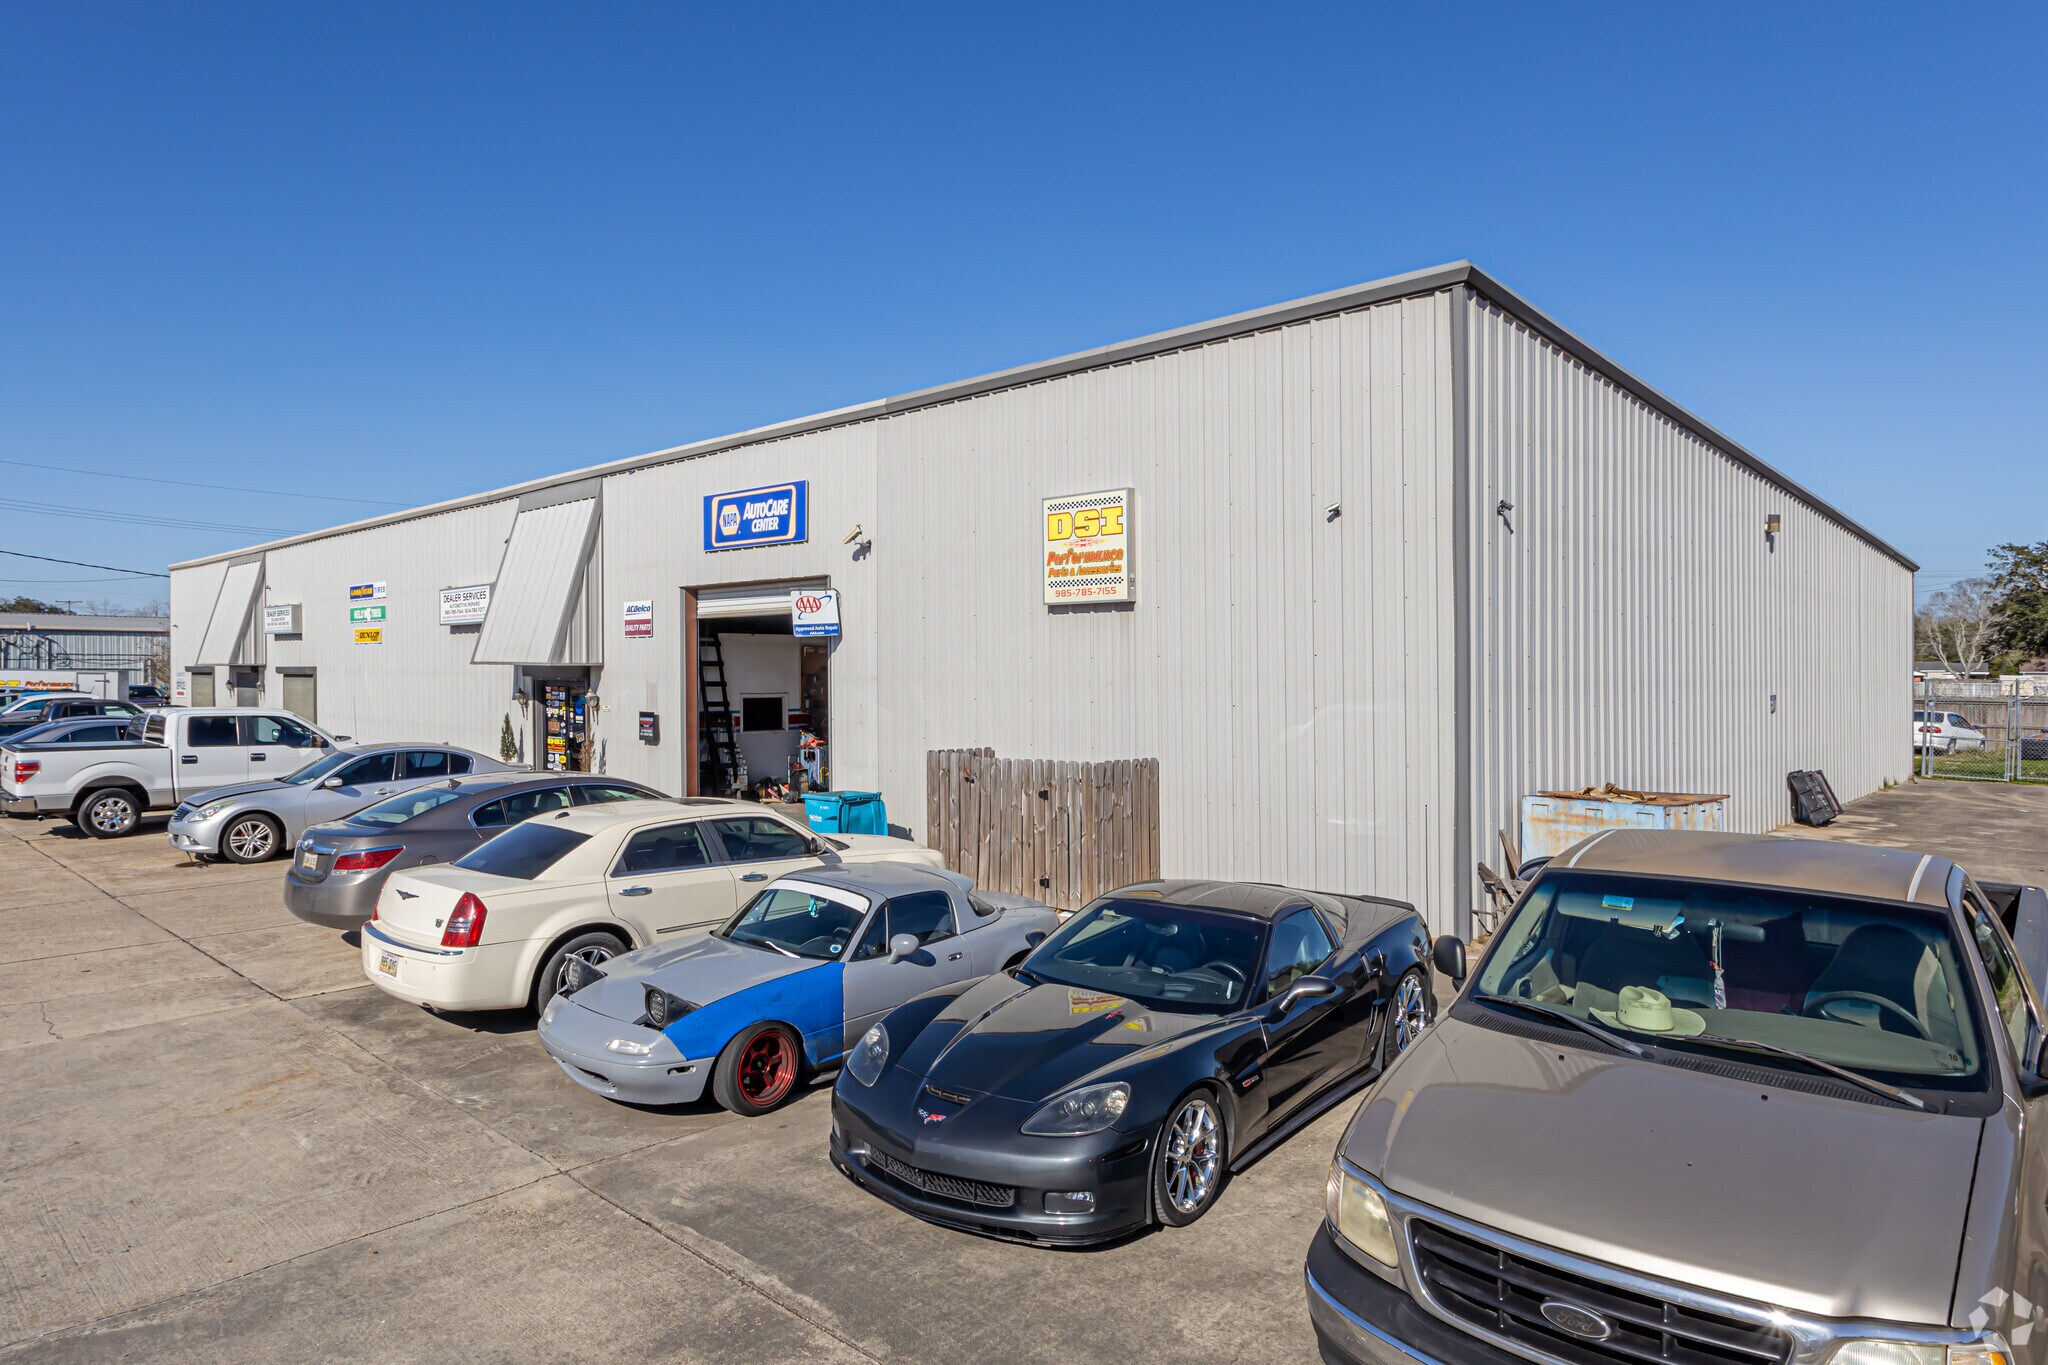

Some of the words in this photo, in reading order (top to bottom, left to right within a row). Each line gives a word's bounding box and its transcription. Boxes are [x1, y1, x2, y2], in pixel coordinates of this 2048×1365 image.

[722, 512, 737, 528] NAPA
[751, 516, 779, 532] CENTER
[1047, 505, 1123, 541] DSI
[1046, 547, 1124, 566] Performance
[1048, 566, 1069, 578] Parts
[443, 593, 461, 603] DEALER
[462, 590, 487, 601] SERVICES
[1055, 586, 1117, 597] 985-785-7155
[626, 604, 651, 613] ACDelco
[796, 596, 821, 613] AAA
[359, 631, 380, 639] DUNLOP
[796, 625, 815, 633] Approved
[1556, 1310, 1594, 1333] Ford
